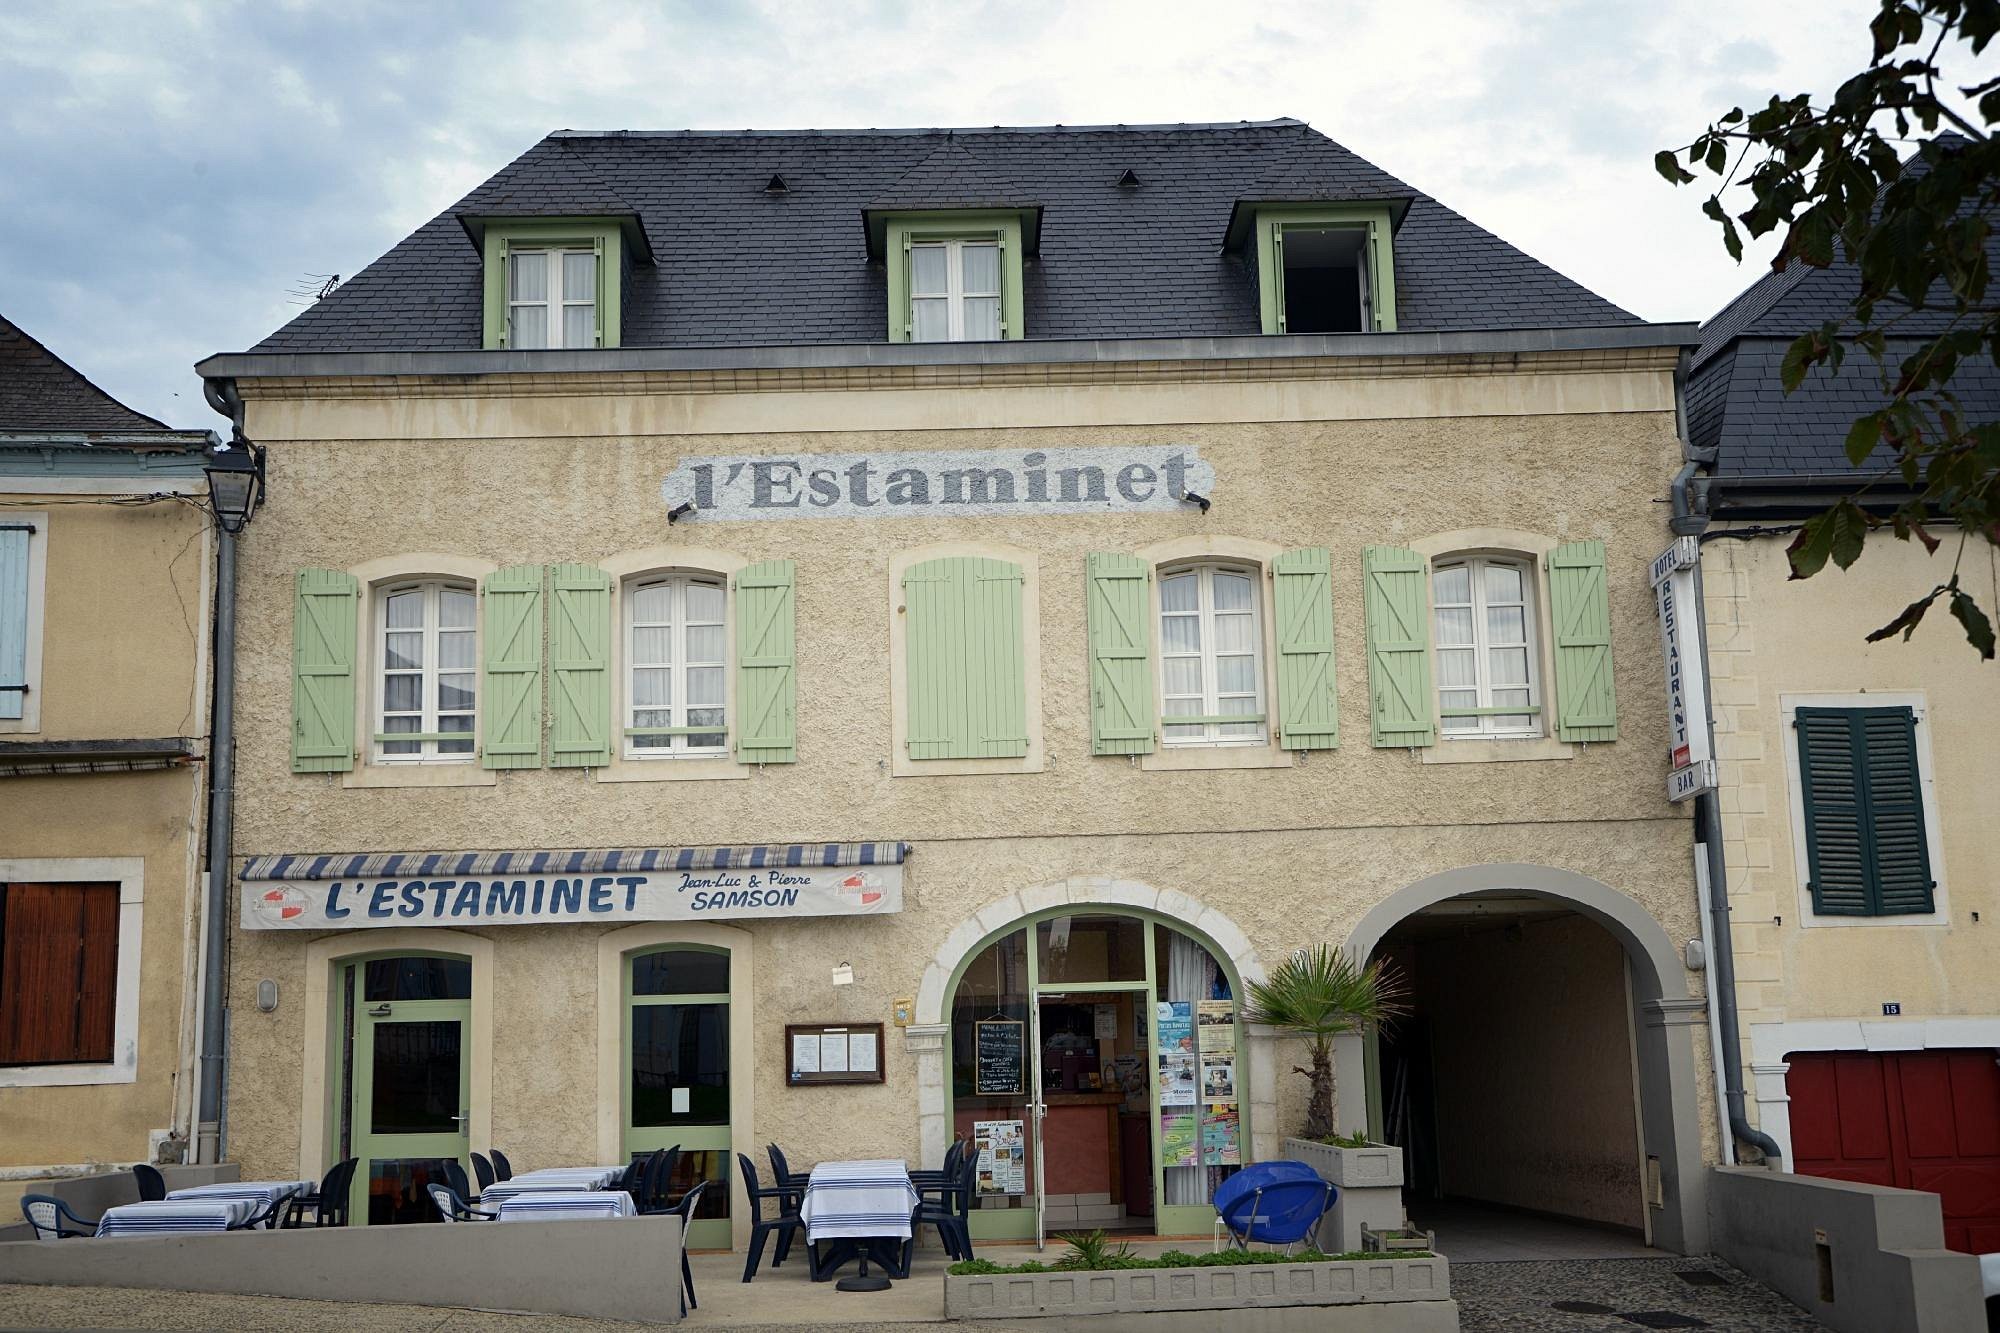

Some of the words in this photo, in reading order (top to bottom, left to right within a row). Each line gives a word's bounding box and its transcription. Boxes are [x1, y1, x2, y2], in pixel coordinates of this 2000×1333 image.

[690, 452, 1195, 510] l'Estaminet
[1654, 549, 1678, 579] HOTEL
[1662, 579, 1685, 743] RESTAURANT
[1677, 771, 1695, 793] BAR
[678, 873, 741, 892] Jean-Luc
[748, 875, 762, 888] &
[769, 870, 811, 885] Pierre
[324, 876, 648, 919] L'ESTAMINET
[691, 889, 799, 911] SAMSON
[1885, 1005, 1897, 1014] 15
